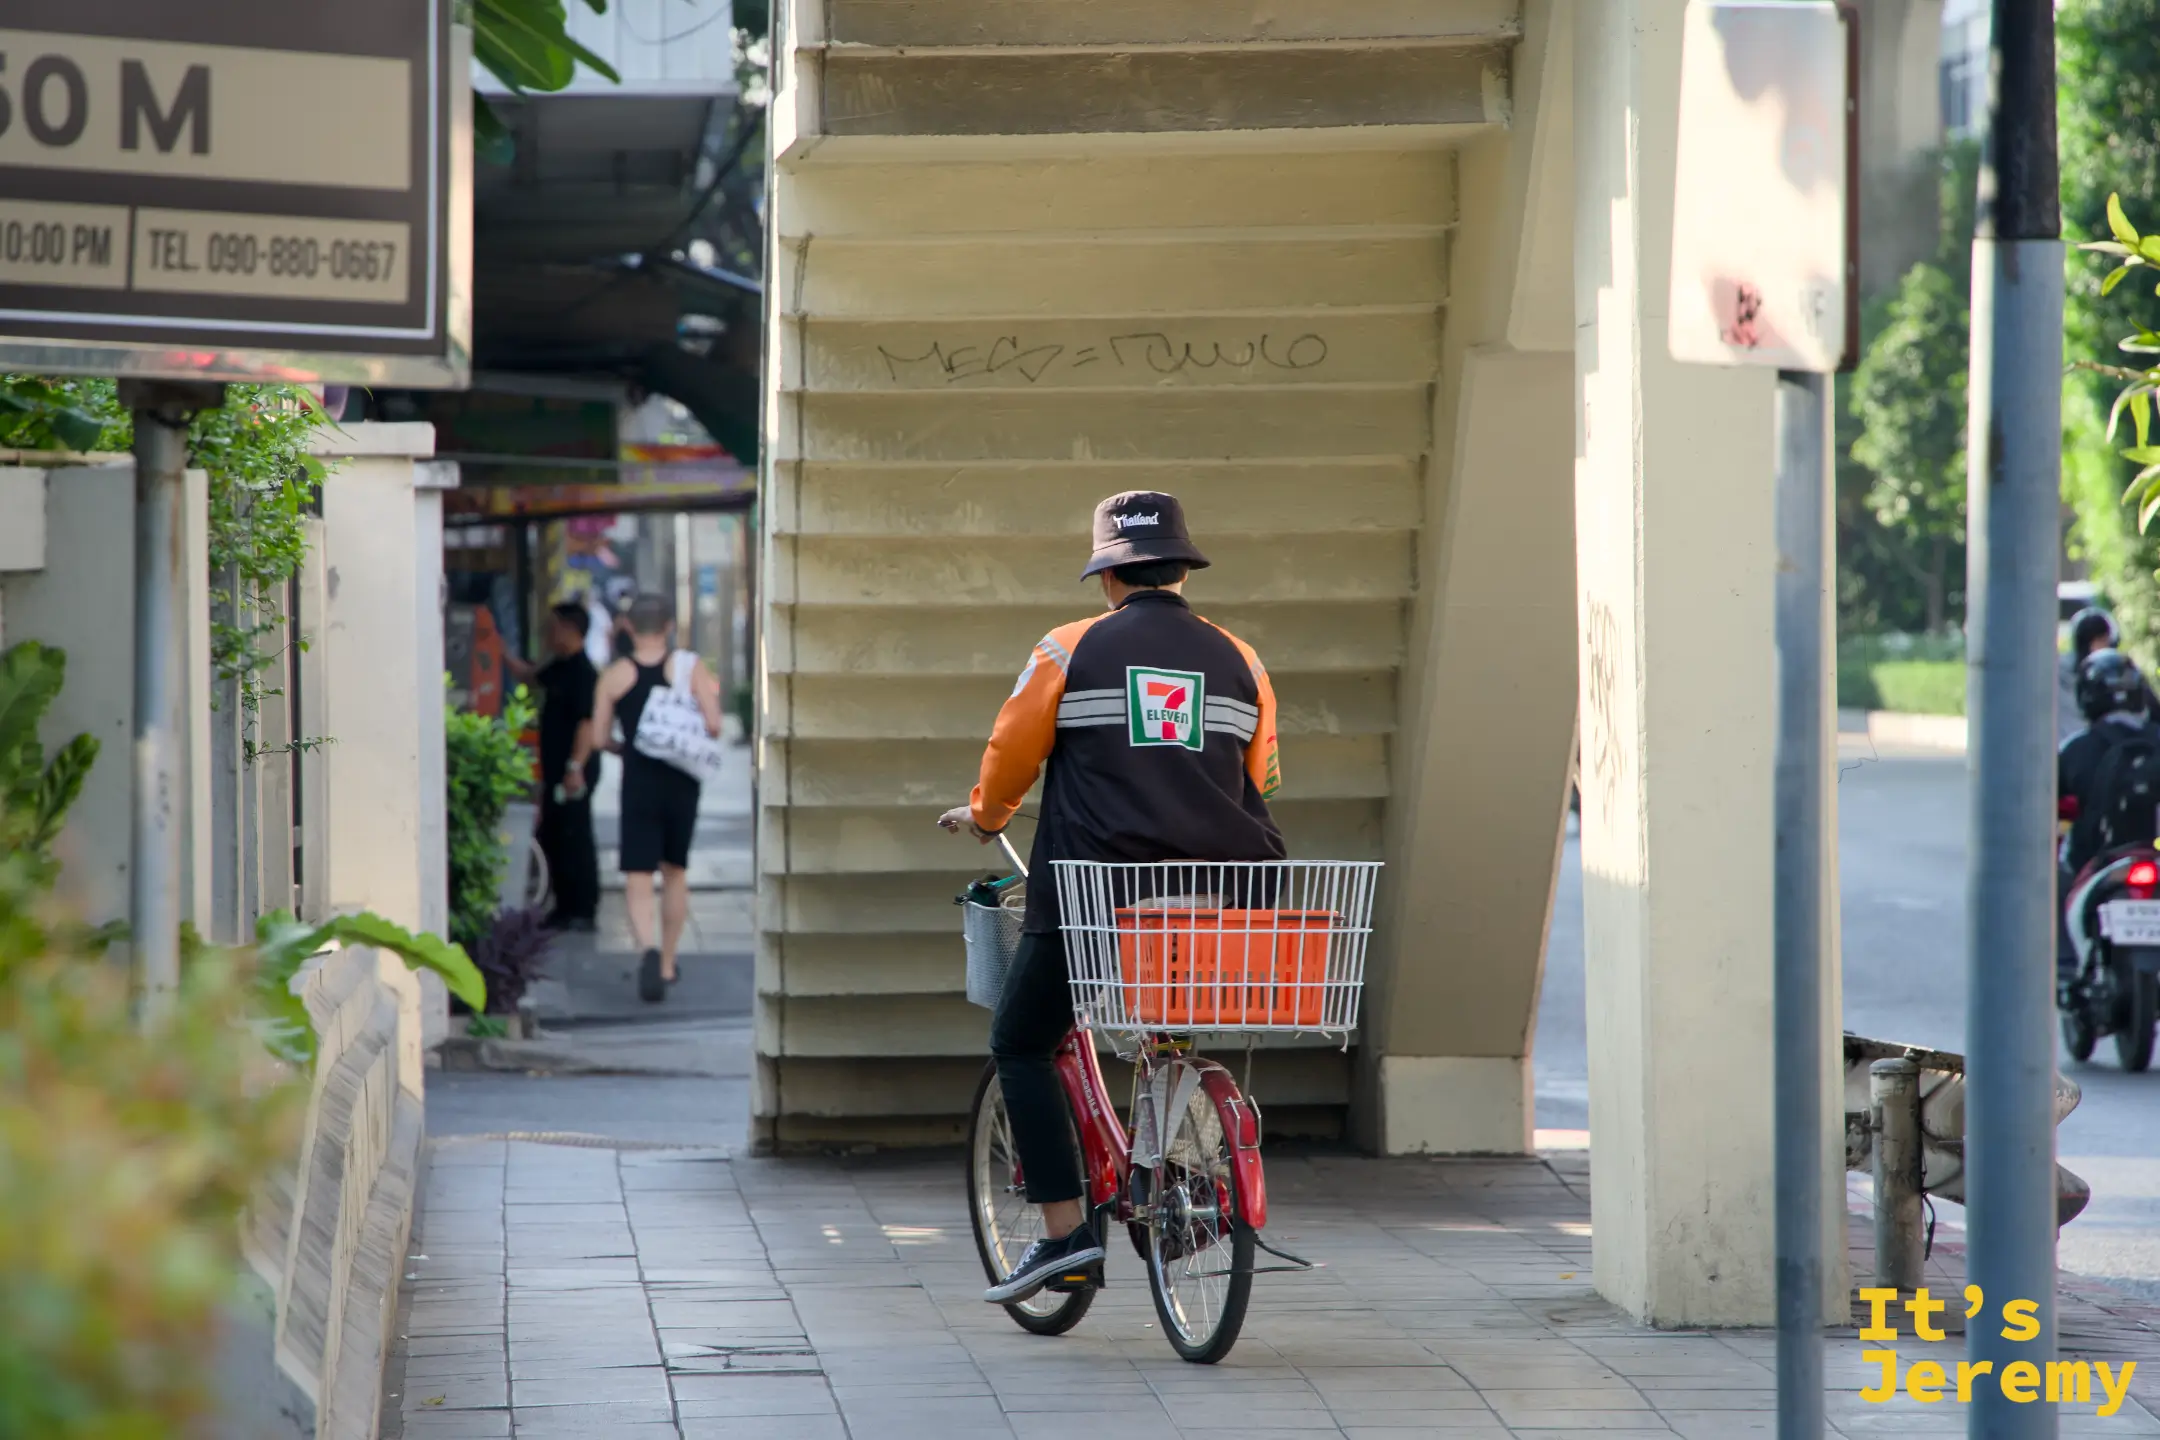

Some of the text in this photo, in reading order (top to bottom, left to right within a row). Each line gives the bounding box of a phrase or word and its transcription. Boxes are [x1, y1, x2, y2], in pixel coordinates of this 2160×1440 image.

[0, 50, 211, 156] 0 M
[0, 221, 112, 268] 0:00 PM
[207, 232, 396, 282] 090-880-0667
[1112, 511, 1160, 529] Thailand
[1147, 681, 1186, 740] 7
